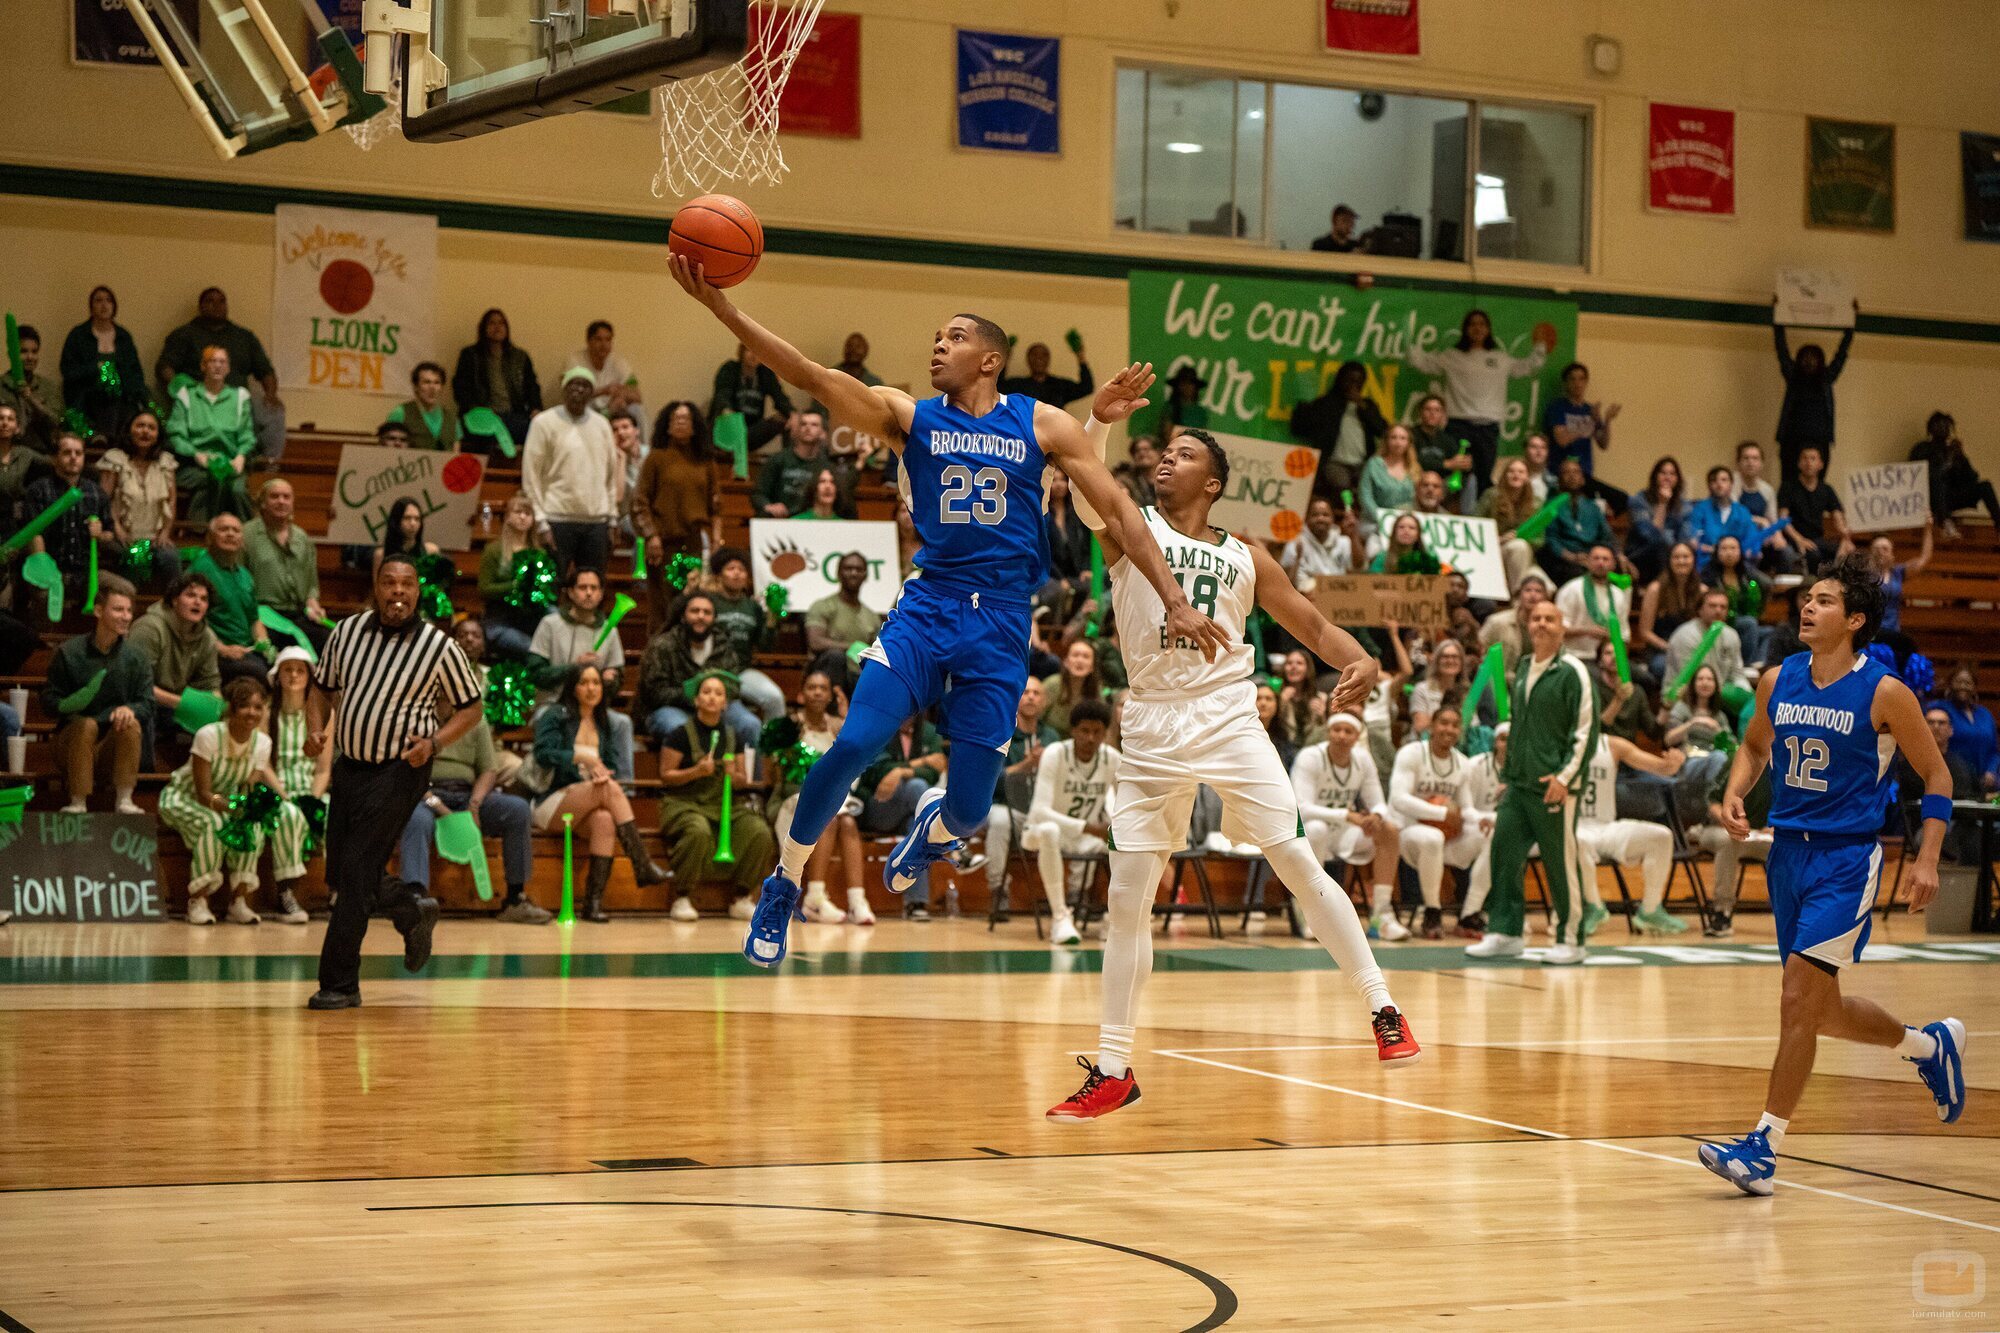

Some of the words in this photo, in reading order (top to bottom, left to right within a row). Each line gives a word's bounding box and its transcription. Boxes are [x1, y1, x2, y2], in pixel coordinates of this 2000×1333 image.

[1164, 279, 1235, 342] We
[1246, 296, 1346, 355] can't
[1354, 300, 1439, 359] hide
[308, 348, 385, 390] DEN
[1266, 359, 1399, 424] LN
[930, 429, 1027, 463] BROOKWOOD
[339, 454, 433, 508] Camden
[940, 464, 1007, 525] 23
[1849, 464, 1924, 494] HUSKY
[362, 488, 447, 542] HL
[1854, 491, 1924, 524] POWER
[1380, 512, 1485, 554] CMDEN
[1164, 546, 1239, 589] AMDEN
[1405, 576, 1435, 592] EAT
[1380, 602, 1444, 622] LUNCH
[1774, 702, 1855, 736] BROOKWOOD
[1784, 735, 1830, 792] 12
[1067, 796, 1097, 821] 27
[12, 874, 67, 917] iON
